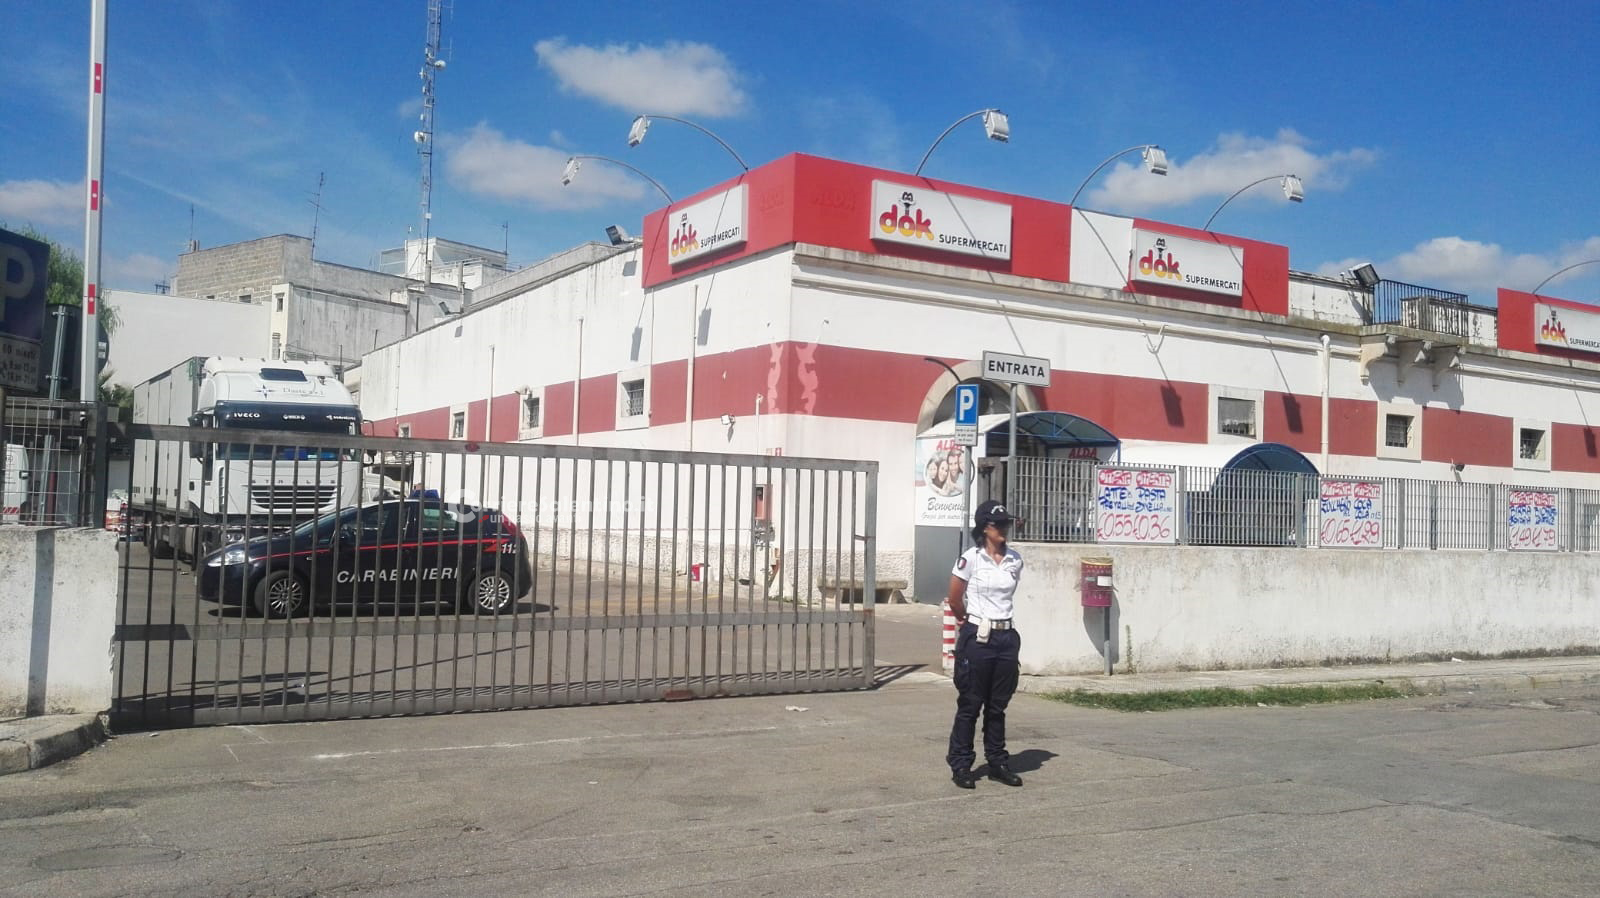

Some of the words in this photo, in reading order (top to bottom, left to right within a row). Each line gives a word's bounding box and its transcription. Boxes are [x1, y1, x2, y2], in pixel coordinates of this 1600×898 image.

[671, 223, 699, 257] dok
[700, 226, 740, 248] SUPERMERCATI
[879, 204, 934, 241] dok
[938, 234, 1007, 253] SUPERMERCATI
[0, 242, 35, 324] P
[1139, 249, 1183, 281] dok
[1185, 274, 1240, 291] SUPERMERCATI
[1541, 318, 1568, 343] dok
[988, 360, 1045, 378] ENTRATA
[959, 388, 975, 421] P
[1068, 446, 1098, 459] ALDA
[1136, 486, 1166, 501] PASTA
